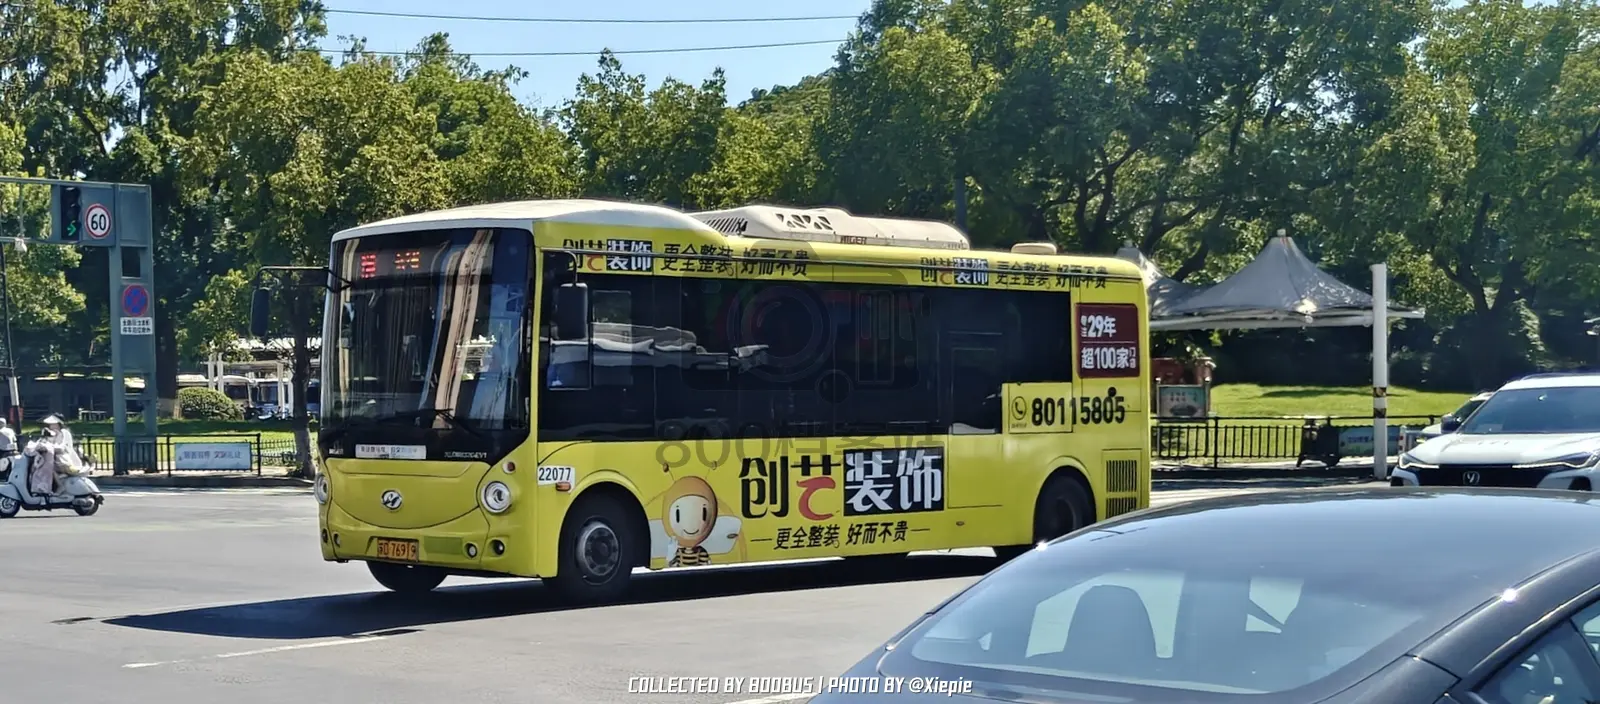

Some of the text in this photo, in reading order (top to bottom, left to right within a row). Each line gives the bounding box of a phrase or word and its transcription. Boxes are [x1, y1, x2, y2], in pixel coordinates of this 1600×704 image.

[90, 214, 107, 232] 60
[1031, 395, 1126, 427] 80115805
[538, 467, 571, 481] 22077
[738, 448, 943, 521] 创艺装饰
[773, 520, 909, 550] 更全整装 好而不贵
